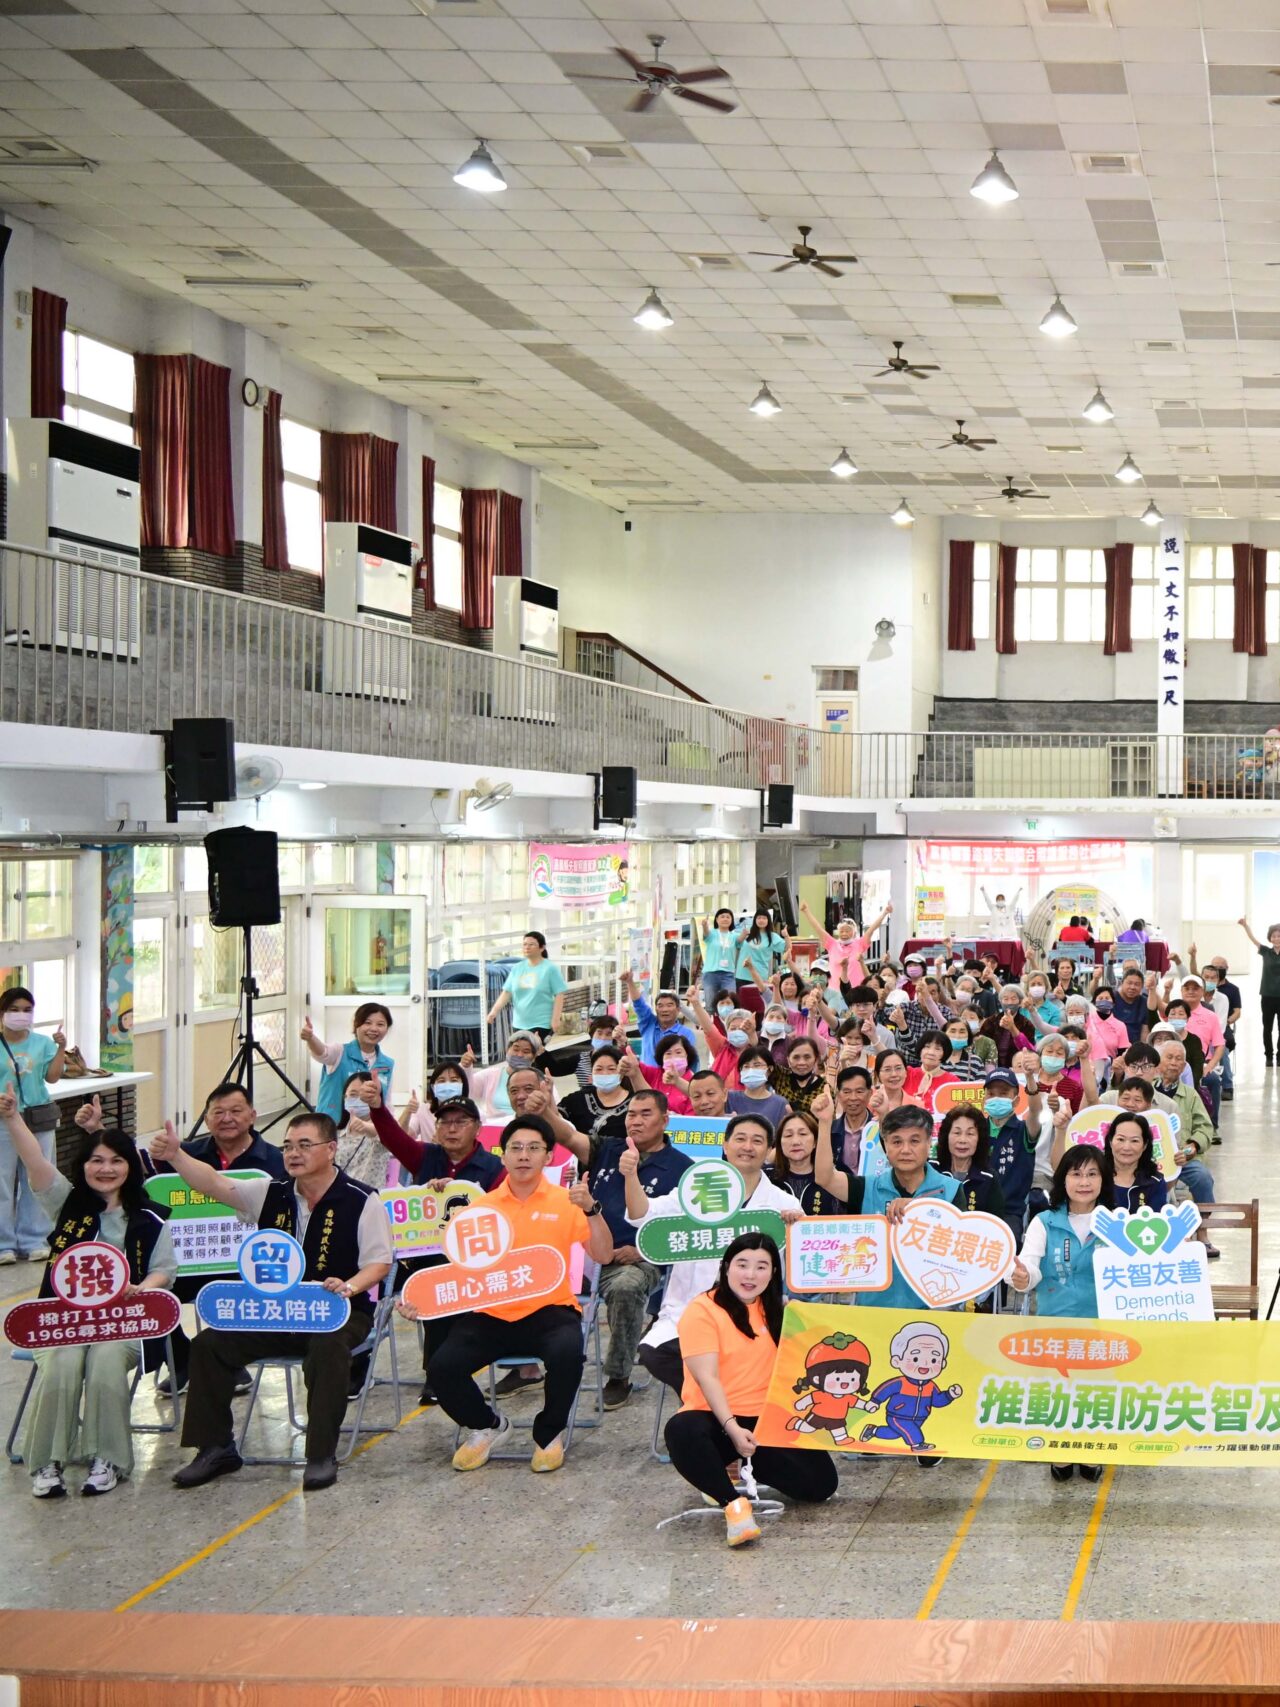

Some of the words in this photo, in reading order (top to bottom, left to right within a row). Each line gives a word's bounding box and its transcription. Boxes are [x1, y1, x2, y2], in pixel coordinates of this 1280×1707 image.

[690, 1169, 732, 1215] 看
[384, 1196, 438, 1225] 1966
[454, 1213, 501, 1264] 問
[800, 1222, 876, 1236] 番路鄉衛生所
[182, 1247, 232, 1260] 獲得休息
[800, 1238, 840, 1251] 2026
[900, 1215, 1005, 1273] 友善環境
[250, 1240, 292, 1285] 留
[1102, 1259, 1203, 1291] 失智友善
[64, 1253, 115, 1299] 撥
[434, 1264, 534, 1306] 關心需求
[214, 1298, 332, 1322] 留住及陪伴
[1114, 1291, 1195, 1311] Dementia
[38, 1304, 146, 1327] 撥打110或
[27, 1319, 160, 1343] 1966尋求協助
[1007, 1336, 1129, 1361] 115年嘉義縣
[979, 1437, 1017, 1446] 主辦單位
[1048, 1440, 1118, 1450] 嘉義縣衛生局
[1134, 1444, 1173, 1452] 承辦單位
